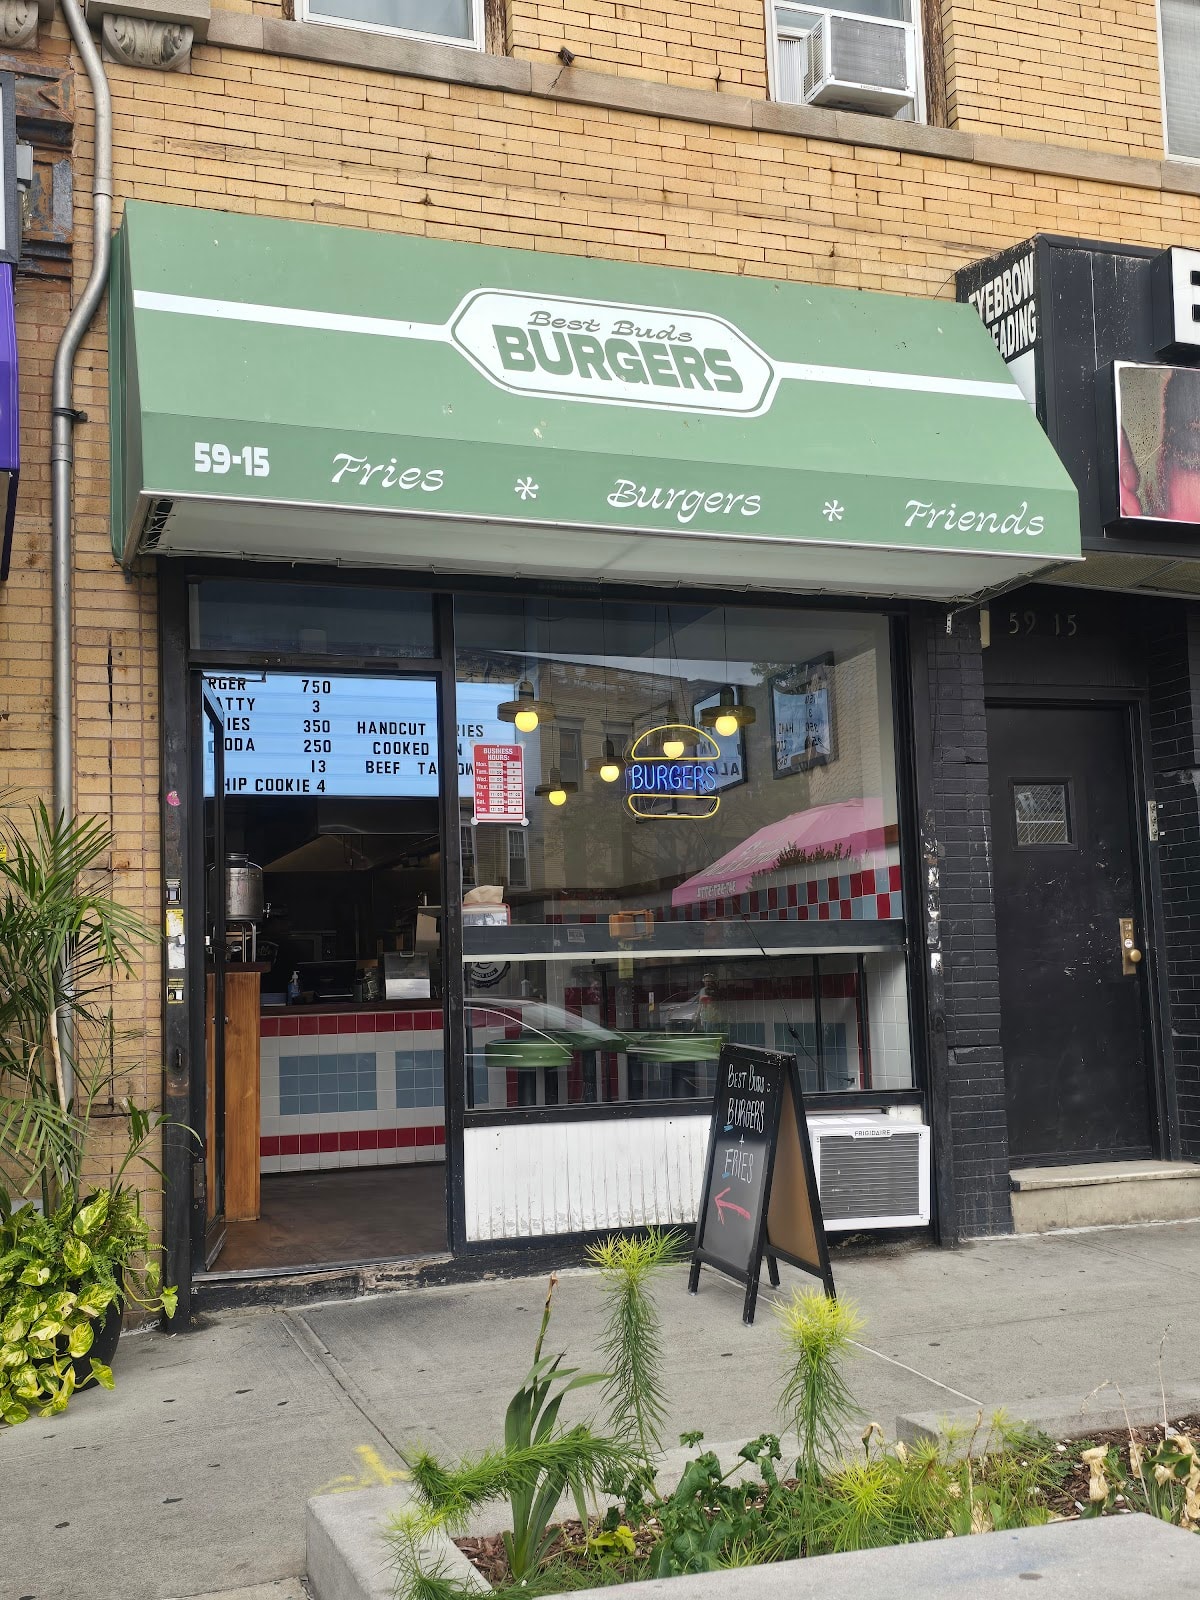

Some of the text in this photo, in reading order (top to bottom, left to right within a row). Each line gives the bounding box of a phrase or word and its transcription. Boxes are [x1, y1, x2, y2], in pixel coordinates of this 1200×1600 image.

[527, 311, 693, 342] Best Buds
[988, 300, 1036, 358] EADING
[492, 324, 743, 393] BURGERS
[195, 442, 270, 477] 59-15
[331, 453, 444, 491] Fries
[607, 479, 761, 524] Burgers
[904, 500, 1044, 536] Friends
[1009, 611, 1077, 636] 59 15
[301, 680, 331, 694] 750
[216, 697, 320, 713] TTY 3
[303, 720, 330, 733] 350
[357, 721, 426, 736] HANDCUT
[224, 738, 331, 753] ODA 250
[373, 741, 429, 755] COOKED
[311, 760, 326, 773] 13
[365, 760, 400, 774] BEEF
[631, 764, 717, 791] BURGERS
[255, 779, 310, 793] COOKIE
[317, 779, 325, 793] 4
[726, 1097, 765, 1134] BURGERS
[724, 1148, 754, 1184] FRIES
